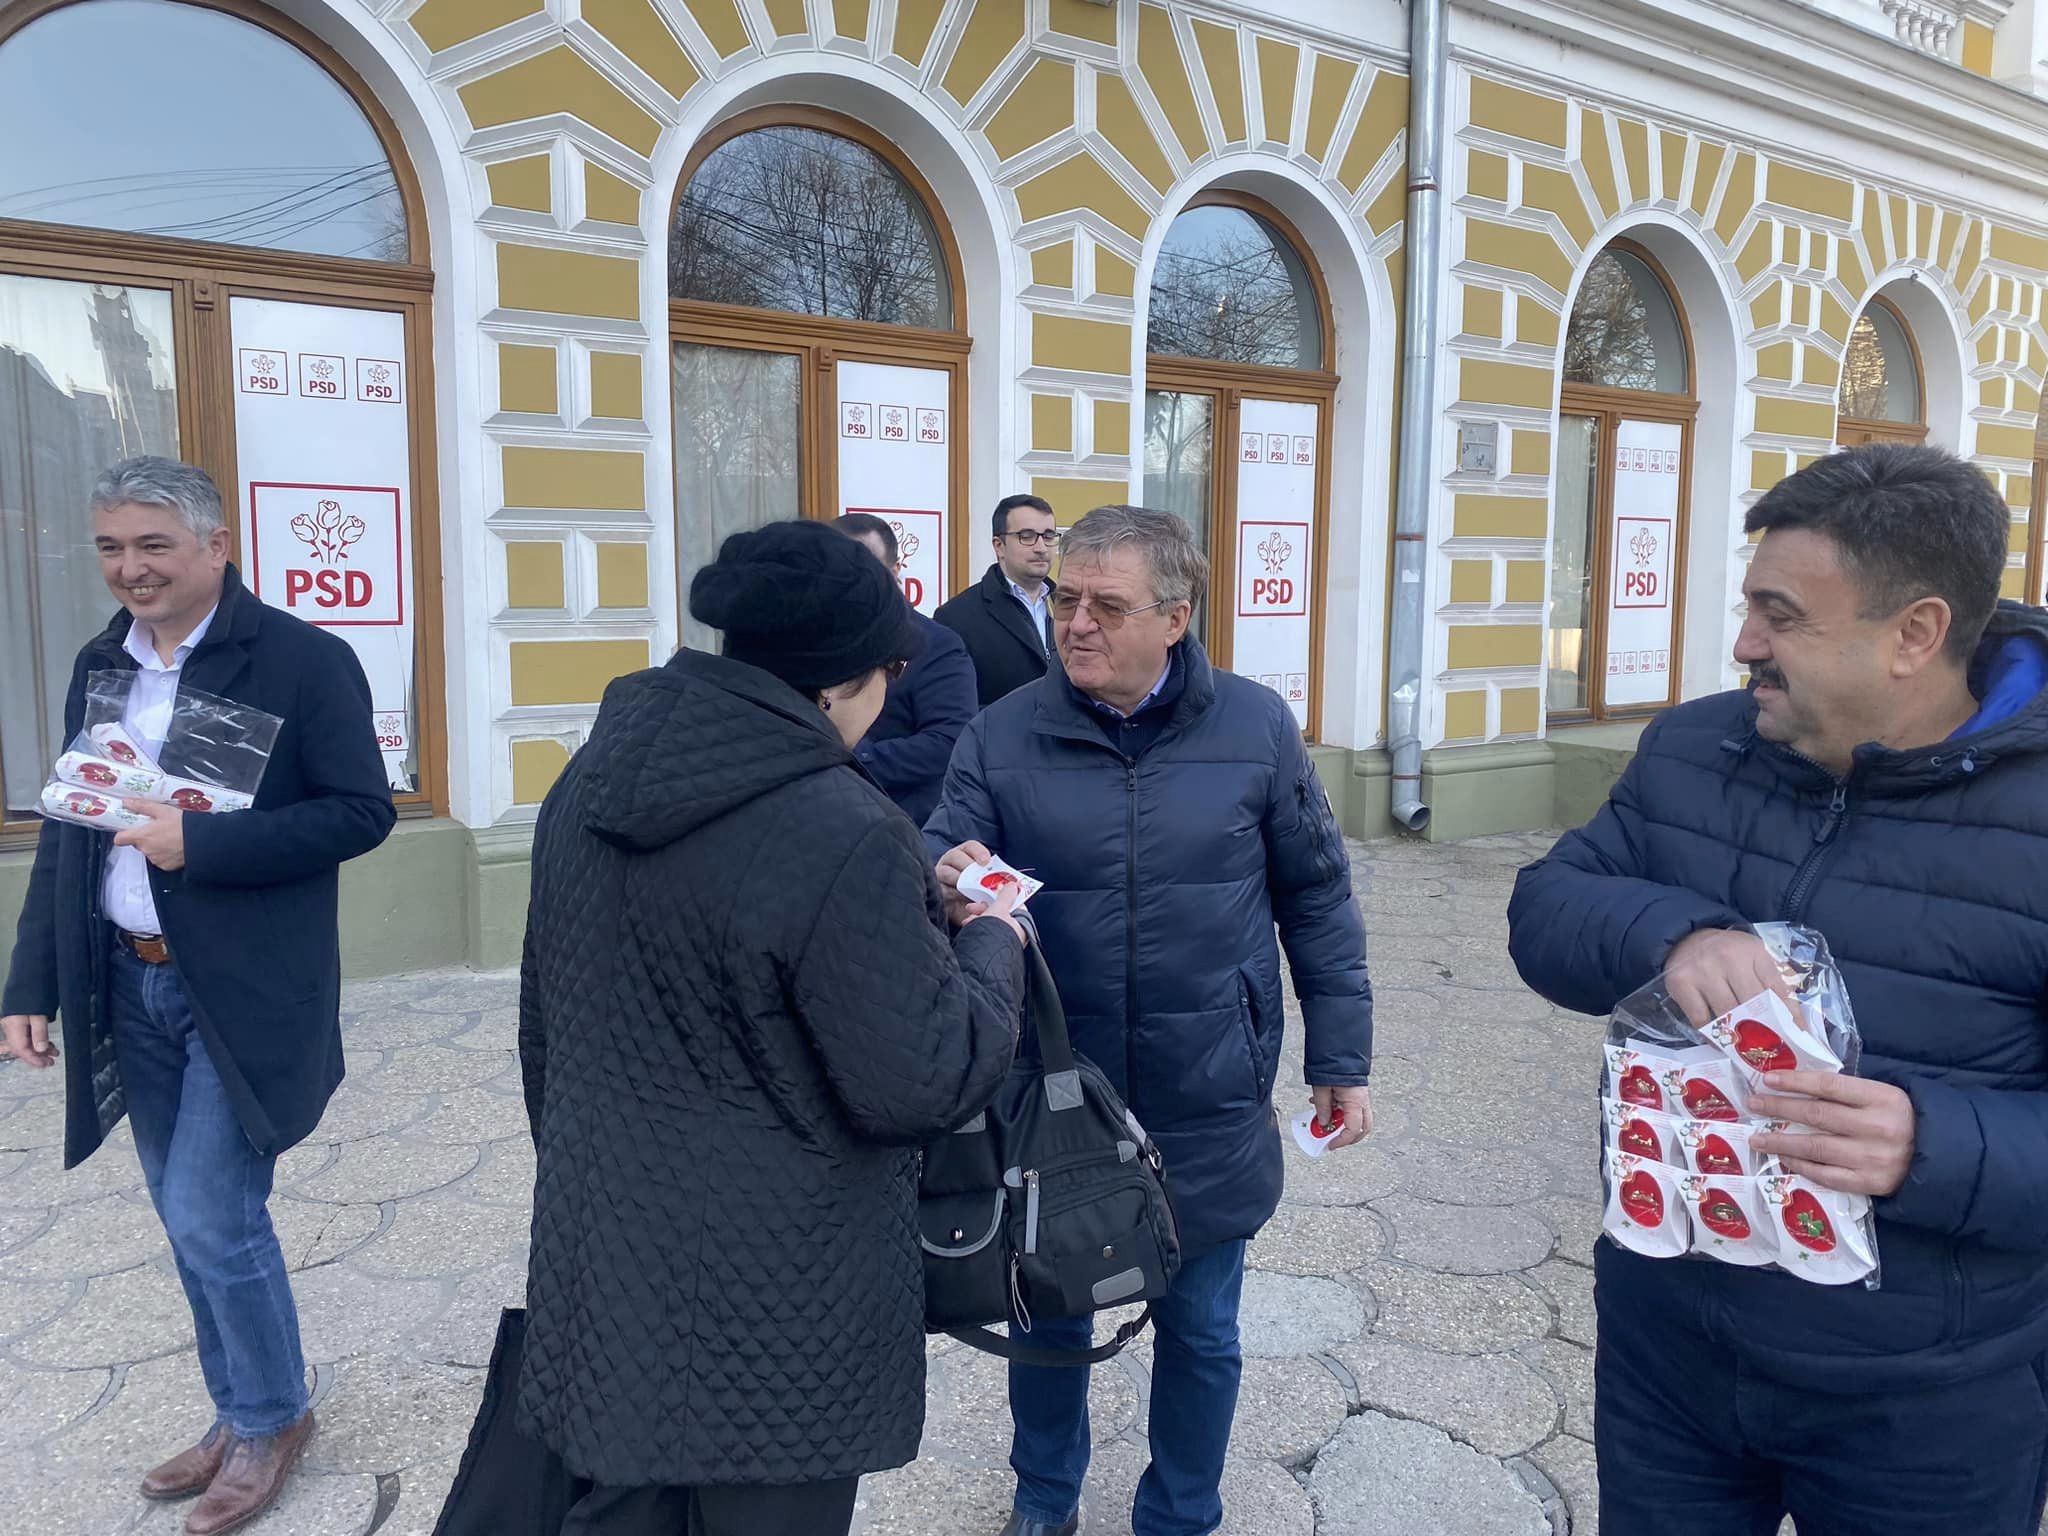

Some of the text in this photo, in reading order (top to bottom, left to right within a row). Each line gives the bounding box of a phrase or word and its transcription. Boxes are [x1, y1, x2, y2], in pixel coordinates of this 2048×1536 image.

[250, 376, 279, 390] PSD
[309, 381, 336, 394] PSD
[366, 385, 392, 398] PSD
[848, 423, 866, 435] PSD
[885, 426, 903, 437] PSD
[921, 429, 939, 440] PSD
[1244, 450, 1258, 460] PSD
[1271, 452, 1284, 461] PSD
[286, 569, 373, 607] PSD
[1625, 571, 1658, 597] PSD
[1253, 578, 1294, 605] PSD
